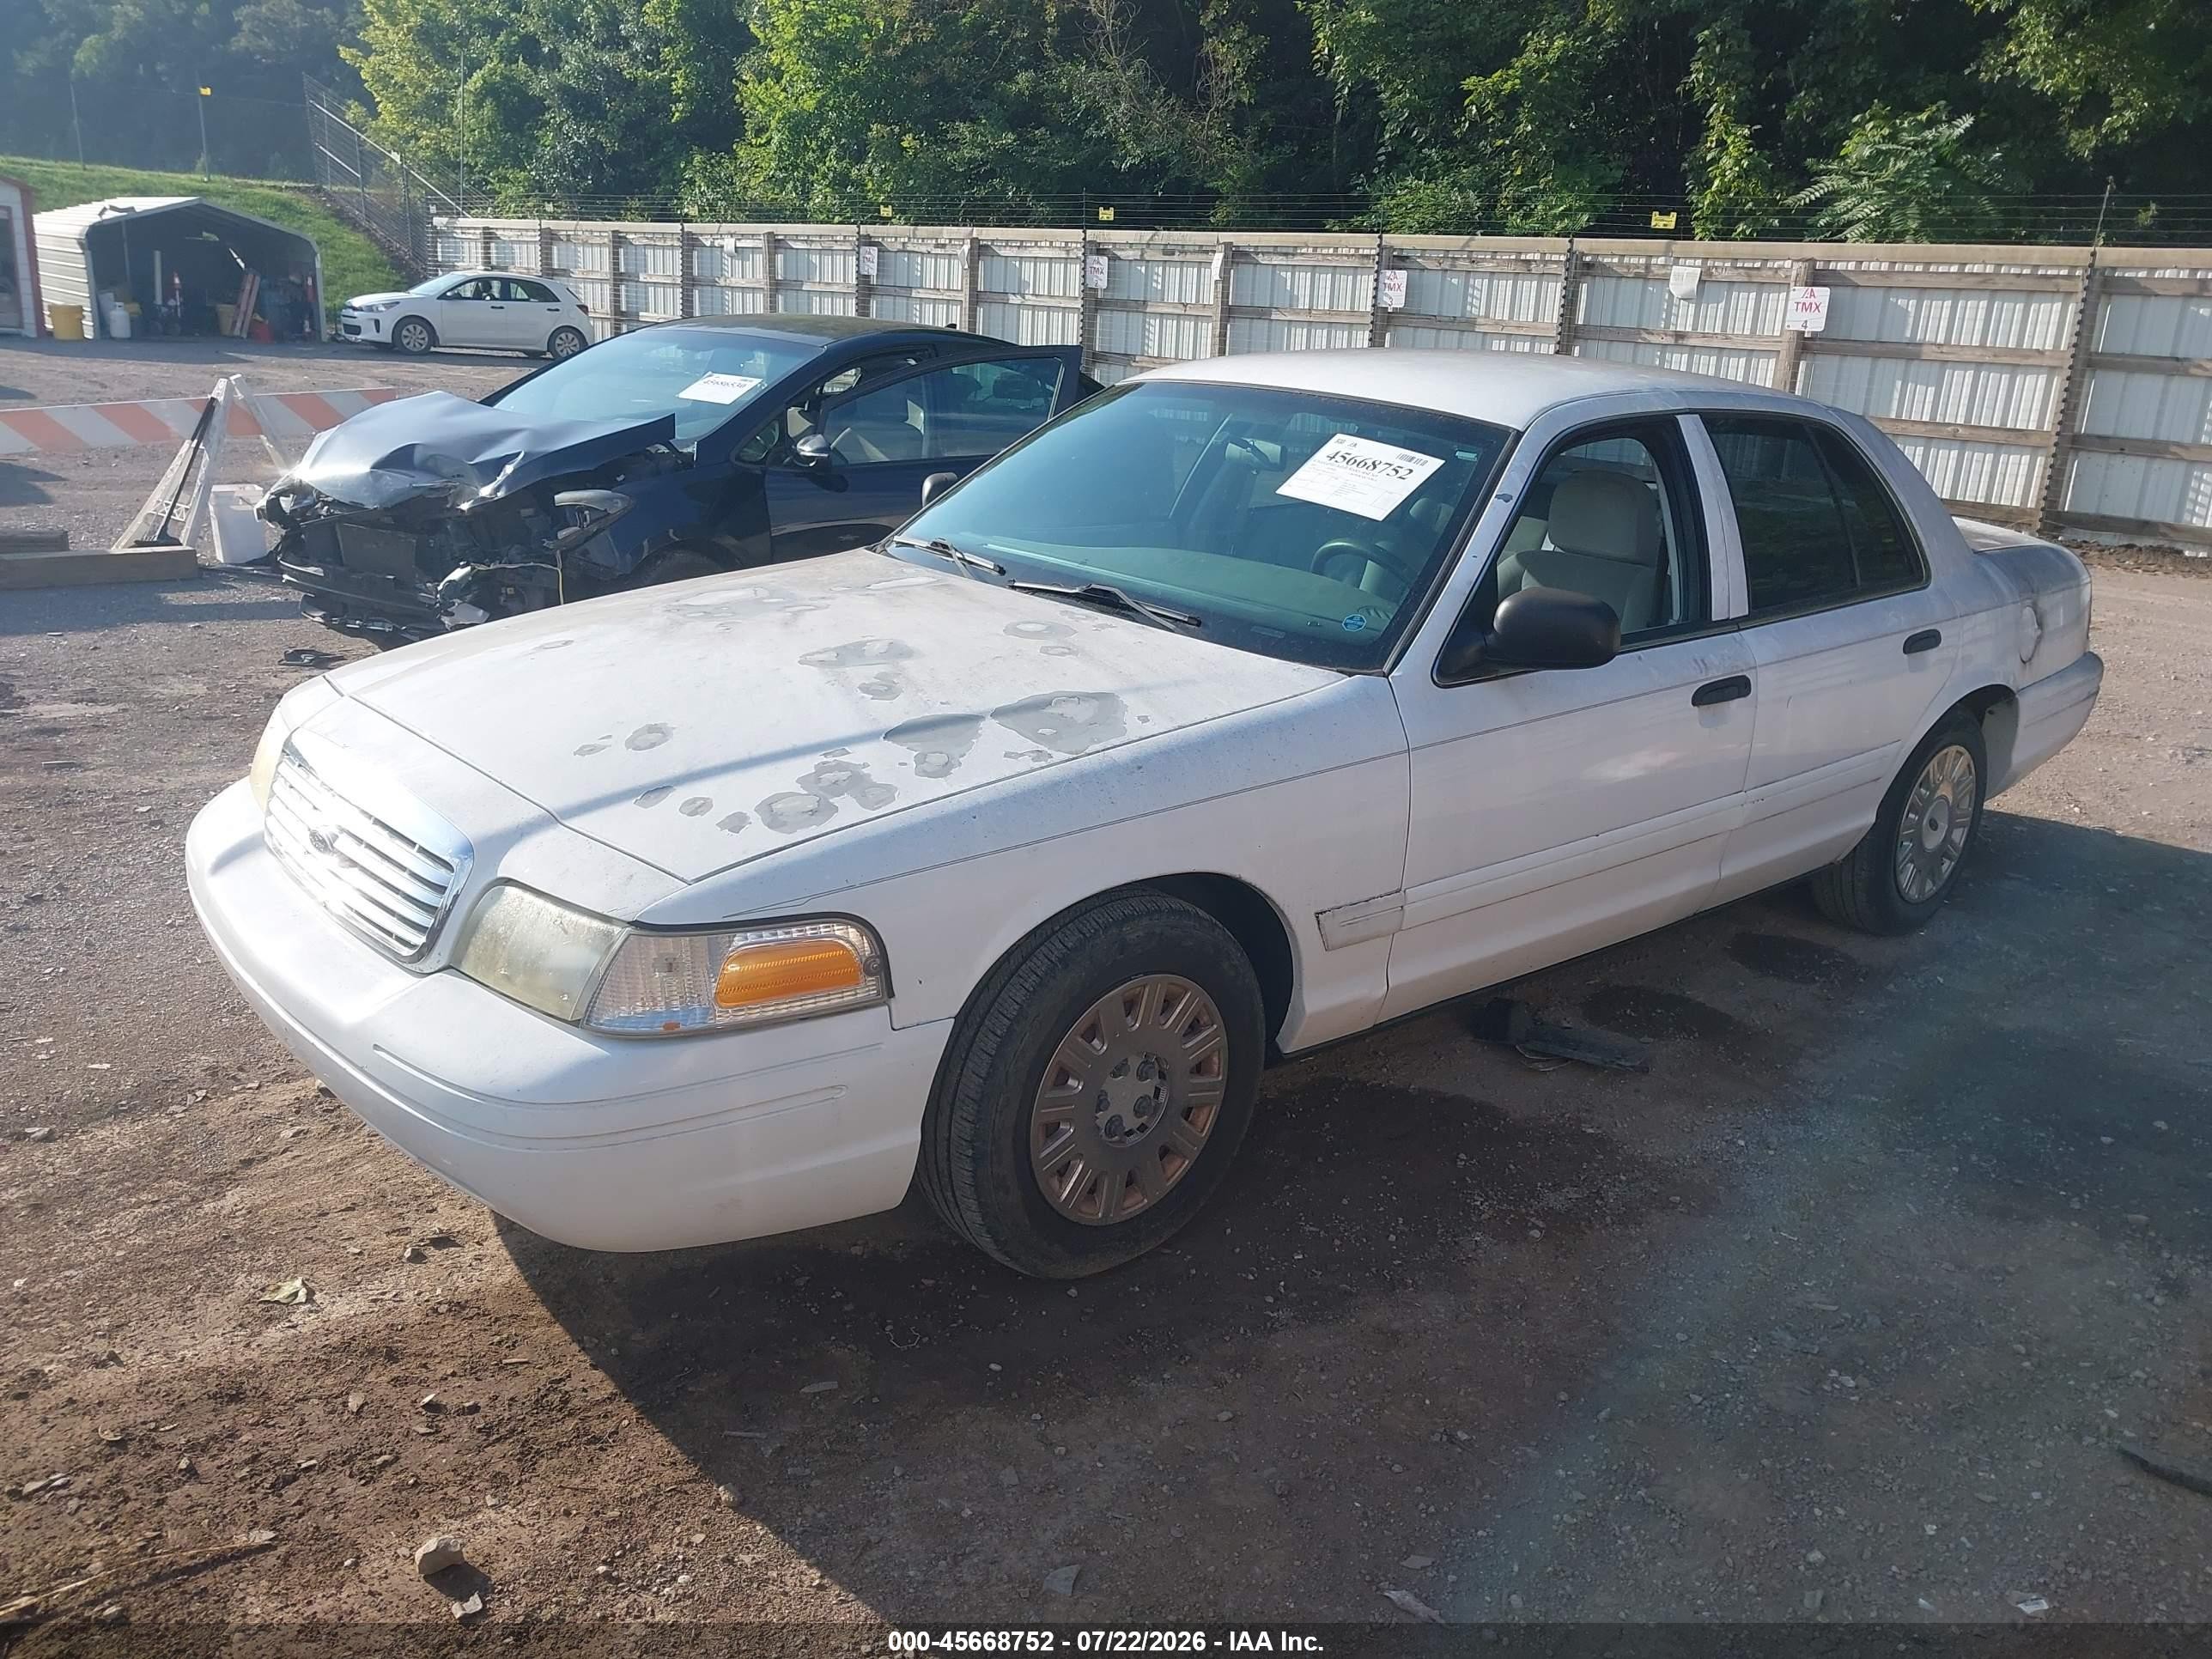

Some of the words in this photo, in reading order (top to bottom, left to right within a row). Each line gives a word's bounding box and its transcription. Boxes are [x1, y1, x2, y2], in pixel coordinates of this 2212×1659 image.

[1090, 266, 1104, 276] TMX
[1383, 283, 1402, 292] TMX
[1794, 301, 1822, 313] TMX
[1801, 319, 1808, 330] 4
[1325, 450, 1414, 480] 45668752
